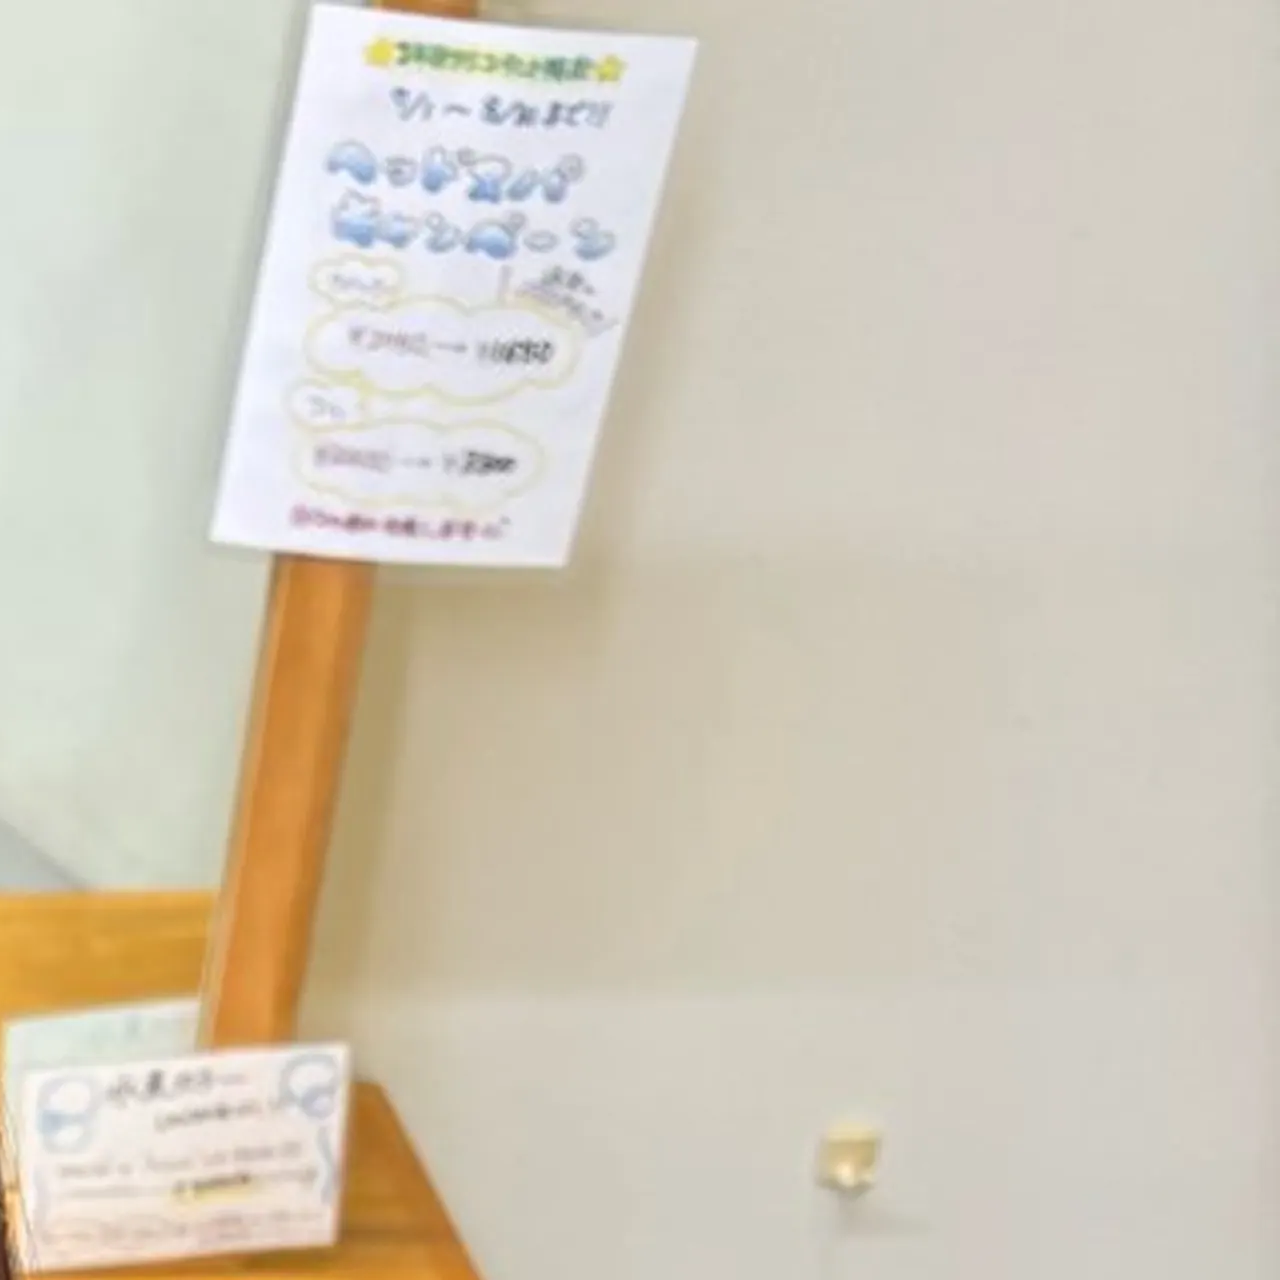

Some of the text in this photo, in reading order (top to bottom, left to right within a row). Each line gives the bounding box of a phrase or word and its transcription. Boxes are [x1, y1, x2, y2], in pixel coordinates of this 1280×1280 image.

[324, 140, 585, 206] ヘッドスパ
[331, 189, 617, 262] キャンペーン
